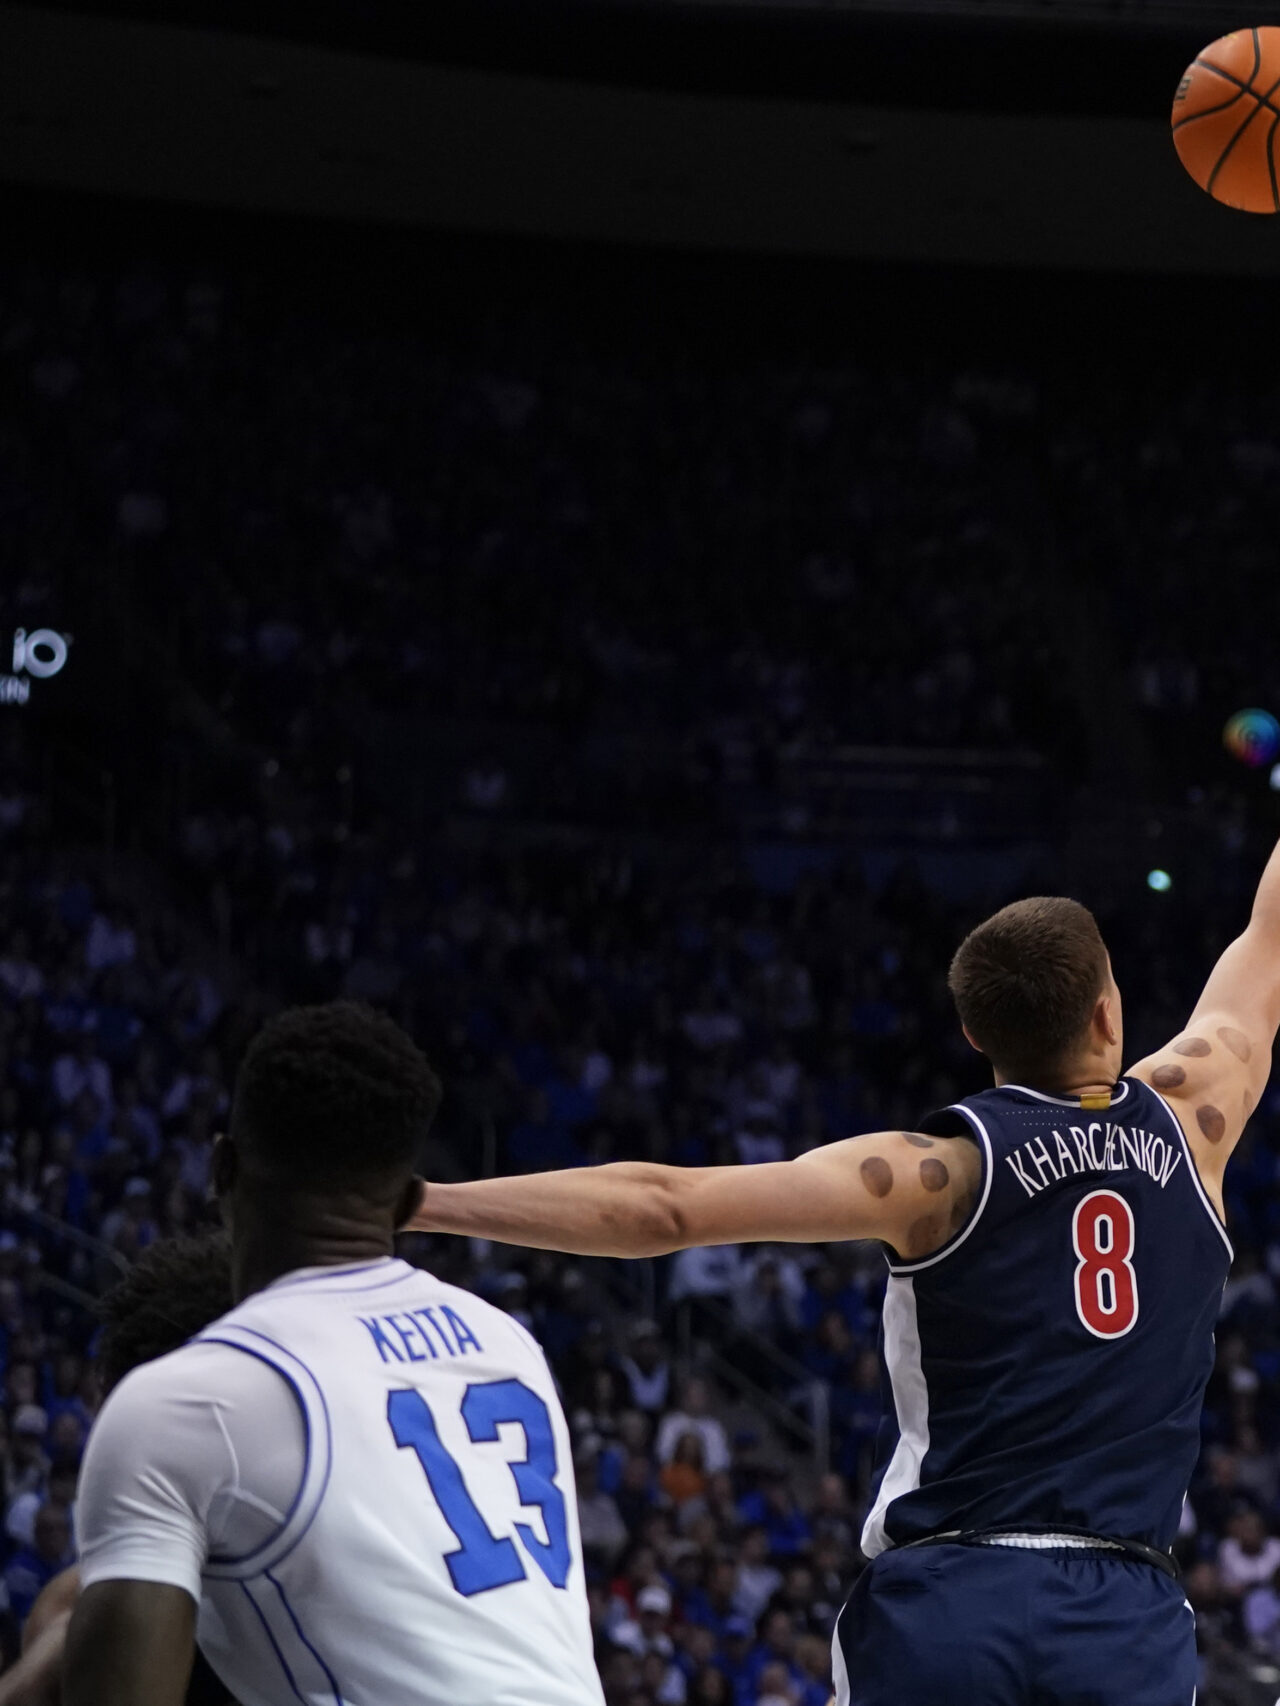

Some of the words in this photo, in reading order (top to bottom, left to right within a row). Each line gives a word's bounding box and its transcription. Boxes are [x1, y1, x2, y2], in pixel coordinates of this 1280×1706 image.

[1005, 1122, 1182, 1198] KHARCHENKOV
[1072, 1189, 1139, 1340] 8
[354, 1304, 484, 1364] KEITA
[386, 1377, 573, 1598] 13
